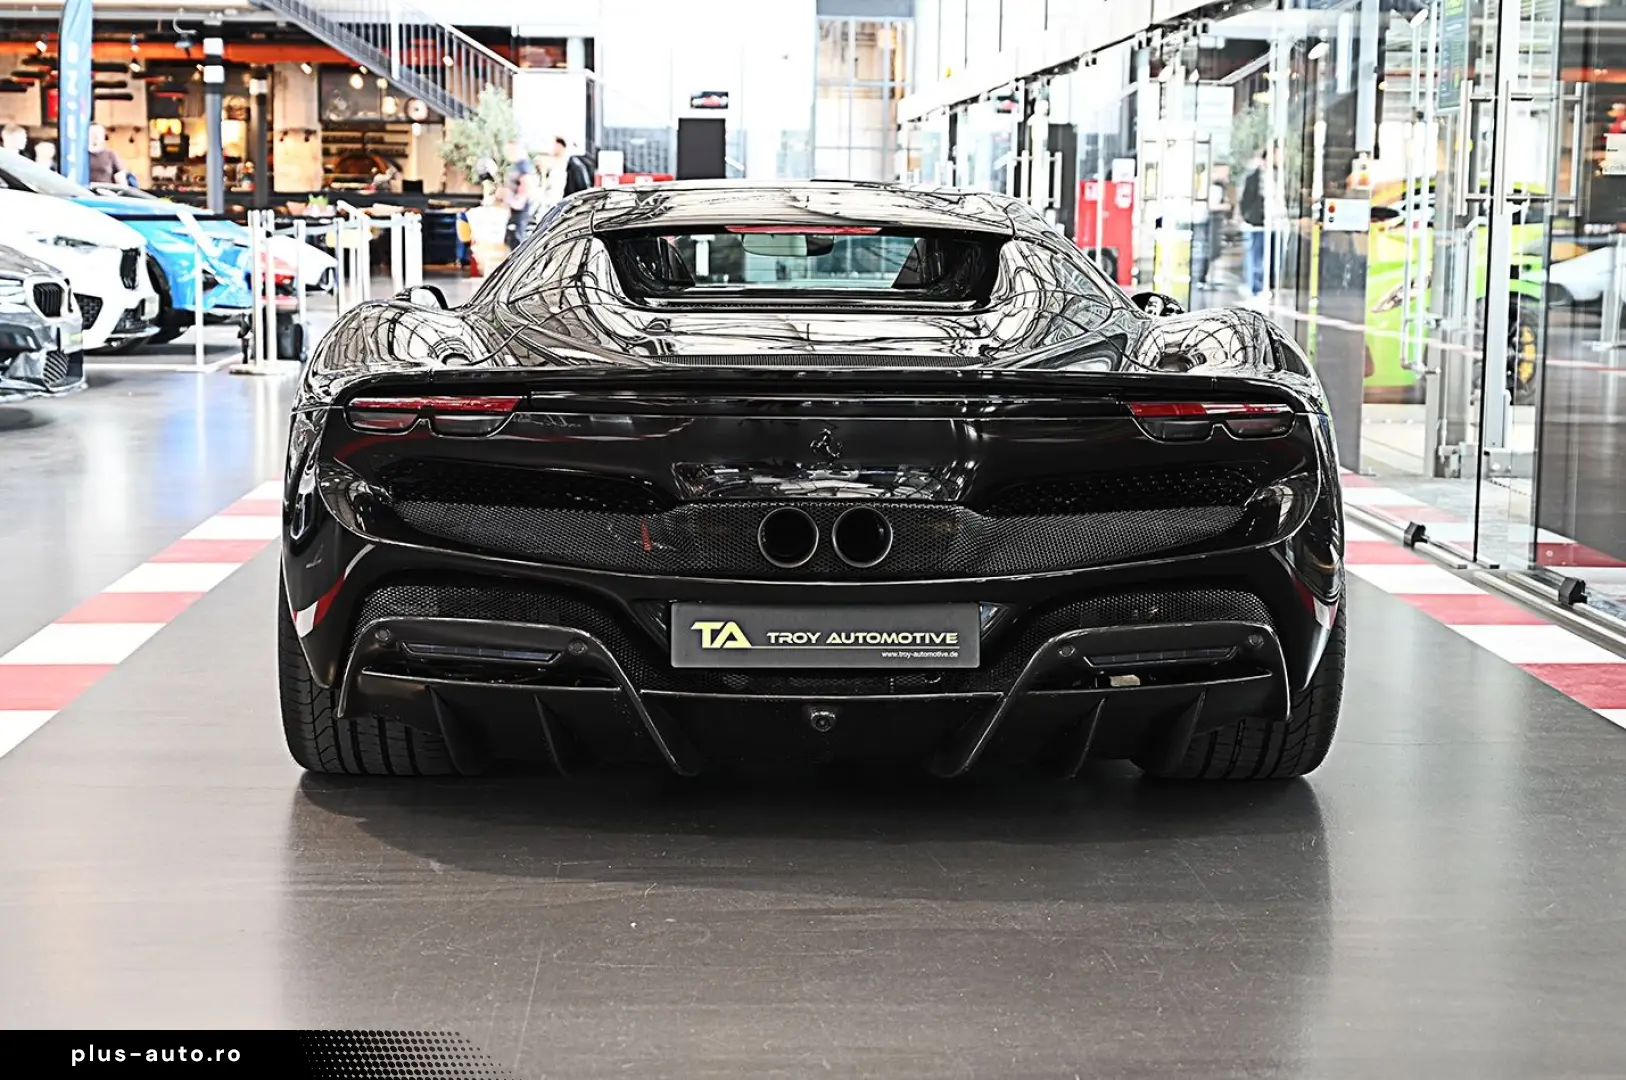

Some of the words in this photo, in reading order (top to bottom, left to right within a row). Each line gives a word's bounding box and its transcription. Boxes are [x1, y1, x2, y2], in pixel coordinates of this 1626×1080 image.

[691, 621, 752, 649] TA
[766, 632, 821, 644] TROY
[826, 632, 958, 644] AUTOMOTIVE
[881, 650, 959, 659] www.troy-automotive.de
